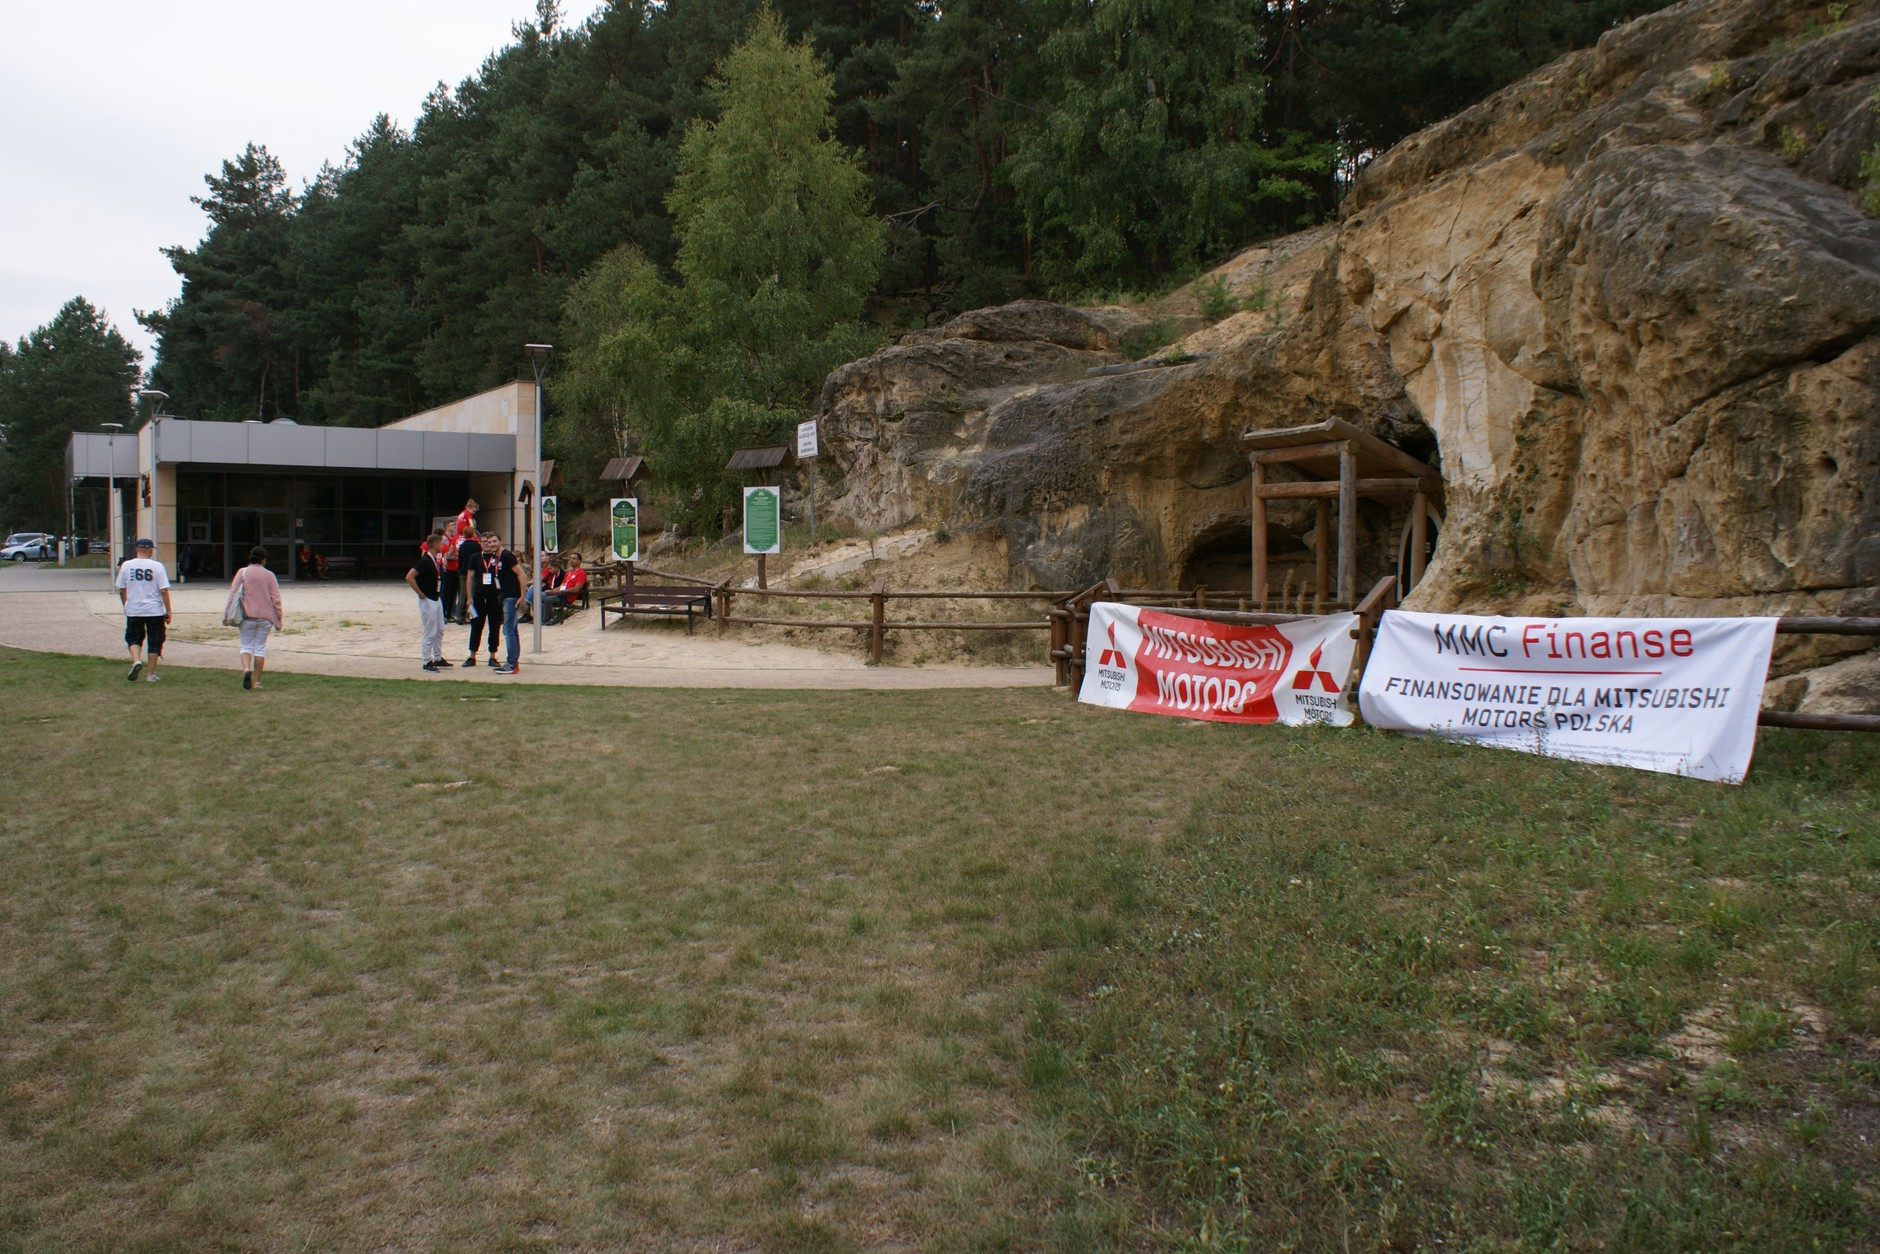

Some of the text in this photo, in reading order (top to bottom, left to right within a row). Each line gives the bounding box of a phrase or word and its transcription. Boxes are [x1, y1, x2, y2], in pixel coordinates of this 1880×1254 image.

[135, 568, 153, 581] 66
[1143, 623, 1286, 670] MITSUBISHI
[1434, 623, 1694, 658] MMC Finanse
[1098, 669, 1125, 681] MITSUBISHI
[1156, 669, 1257, 714] MOTORS
[1295, 694, 1337, 709] MITSUBISH
[1385, 677, 1731, 709] FINANSOWANIE DLA MITSUBISHI
[1462, 708, 1633, 733] MOTORS POLSKA
